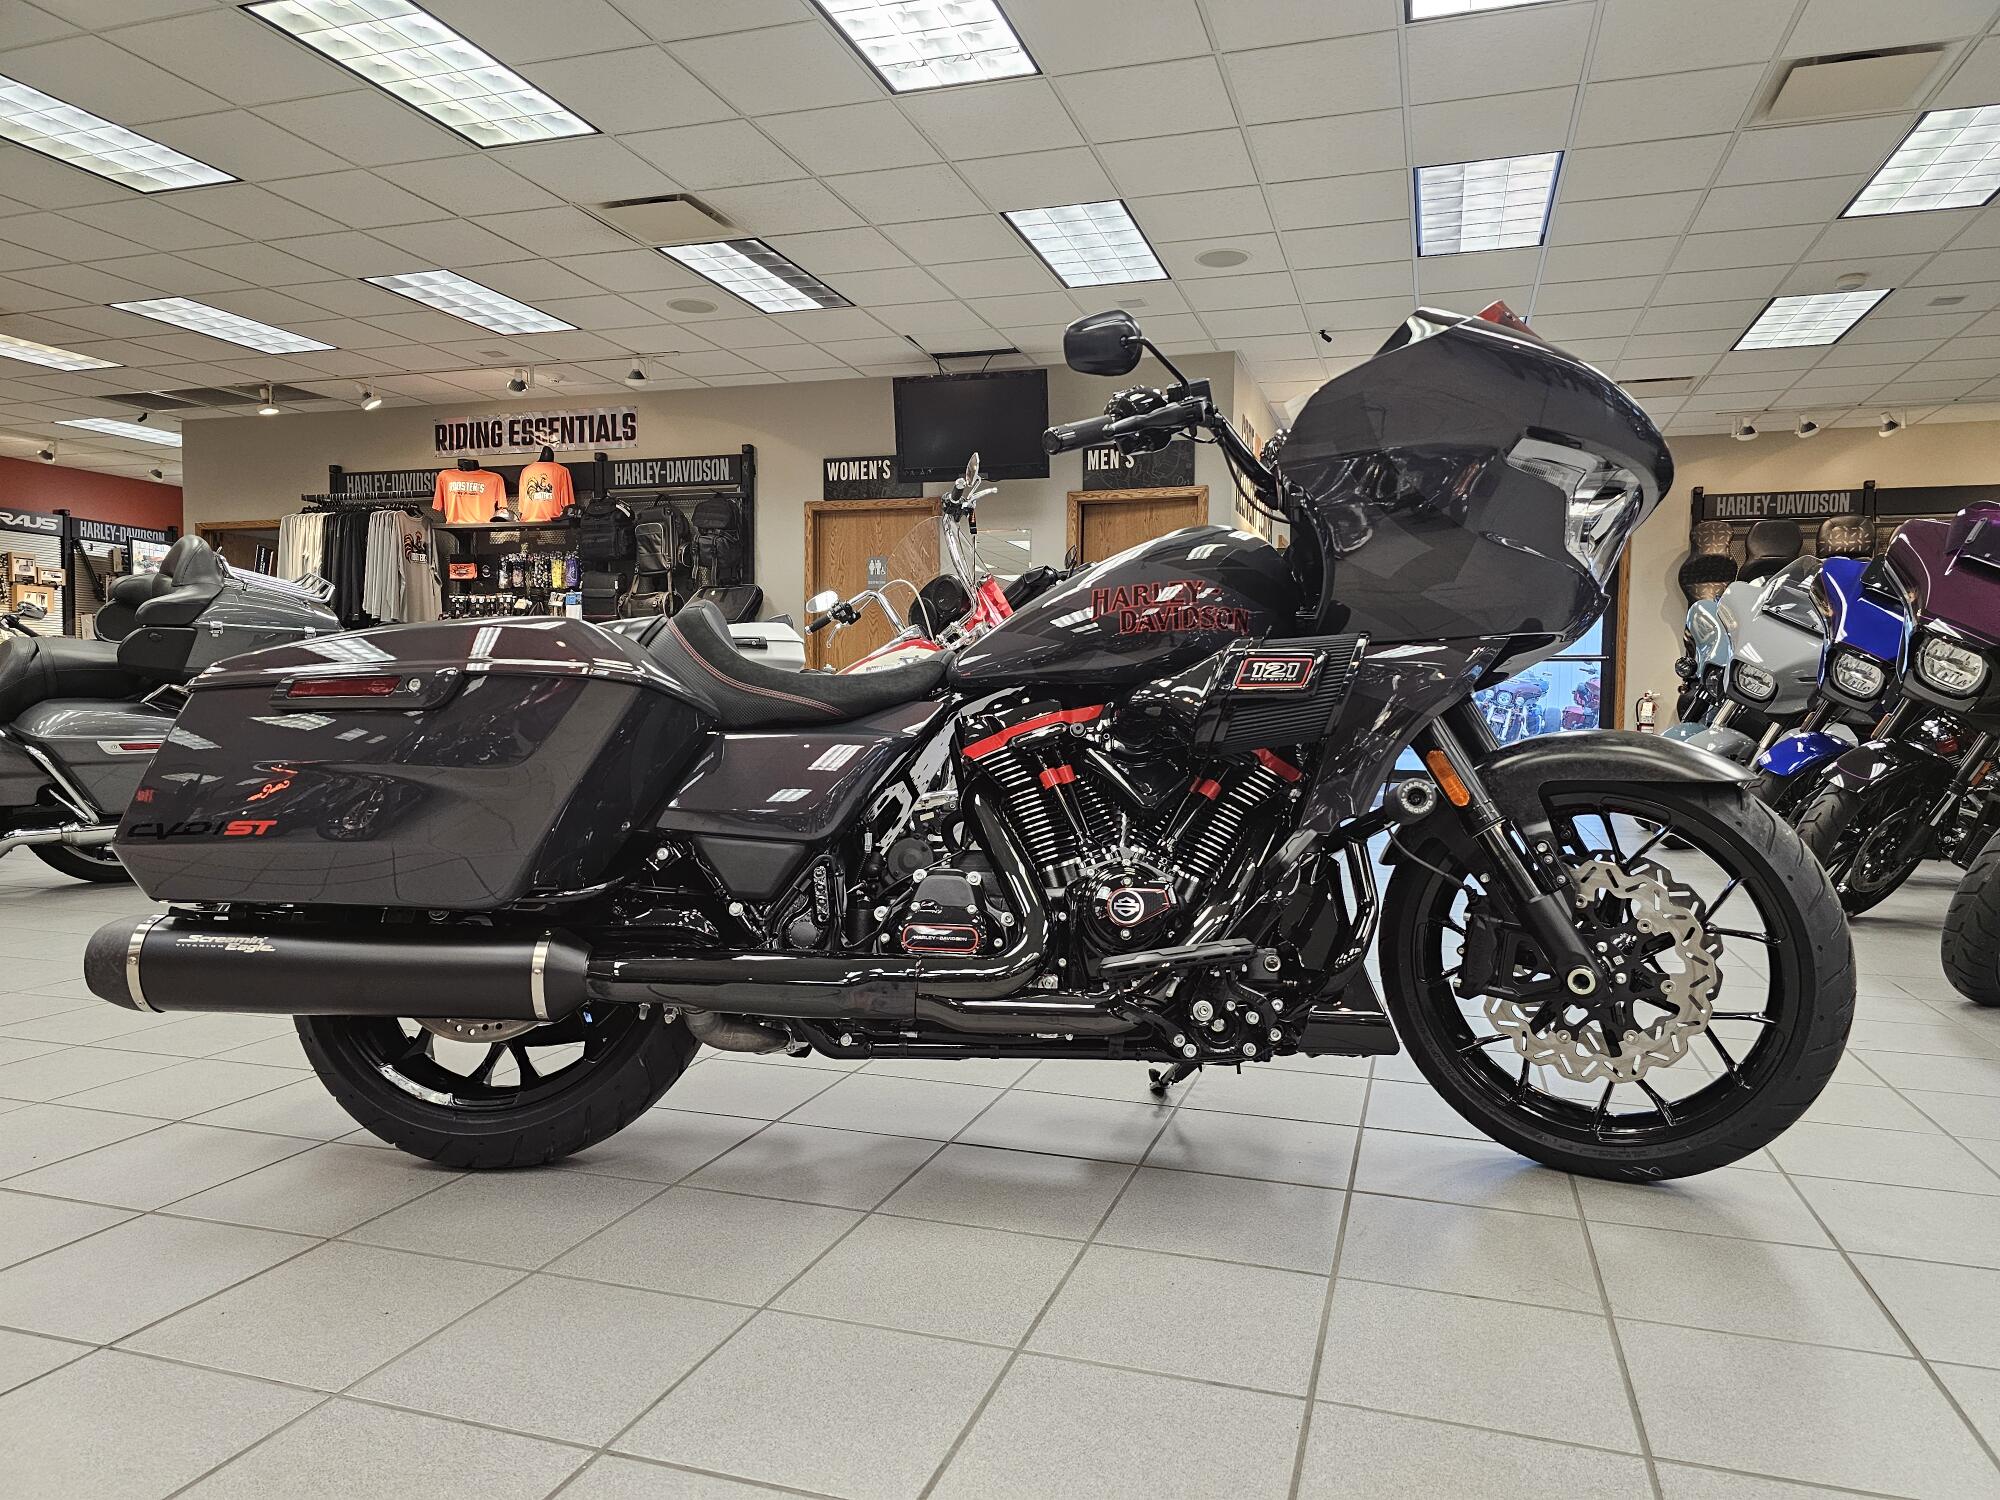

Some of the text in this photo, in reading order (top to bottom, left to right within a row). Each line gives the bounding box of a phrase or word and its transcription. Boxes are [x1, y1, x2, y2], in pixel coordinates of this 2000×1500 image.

[434, 412, 636, 451] RIDING ESSENTIALS
[826, 459, 891, 481] WOMEN'S
[1087, 448, 1135, 471] MENS
[346, 471, 438, 495] HARLEY-DAVIDSO
[614, 457, 730, 486] HARLEY-DAVIDSON
[1715, 492, 1851, 517] HARLEY-DAVIDSON
[1119, 604, 1249, 636] DAVIDSON
[1251, 662, 1300, 678] 121
[223, 819, 277, 836] ST
[224, 942, 276, 953] Eagle
